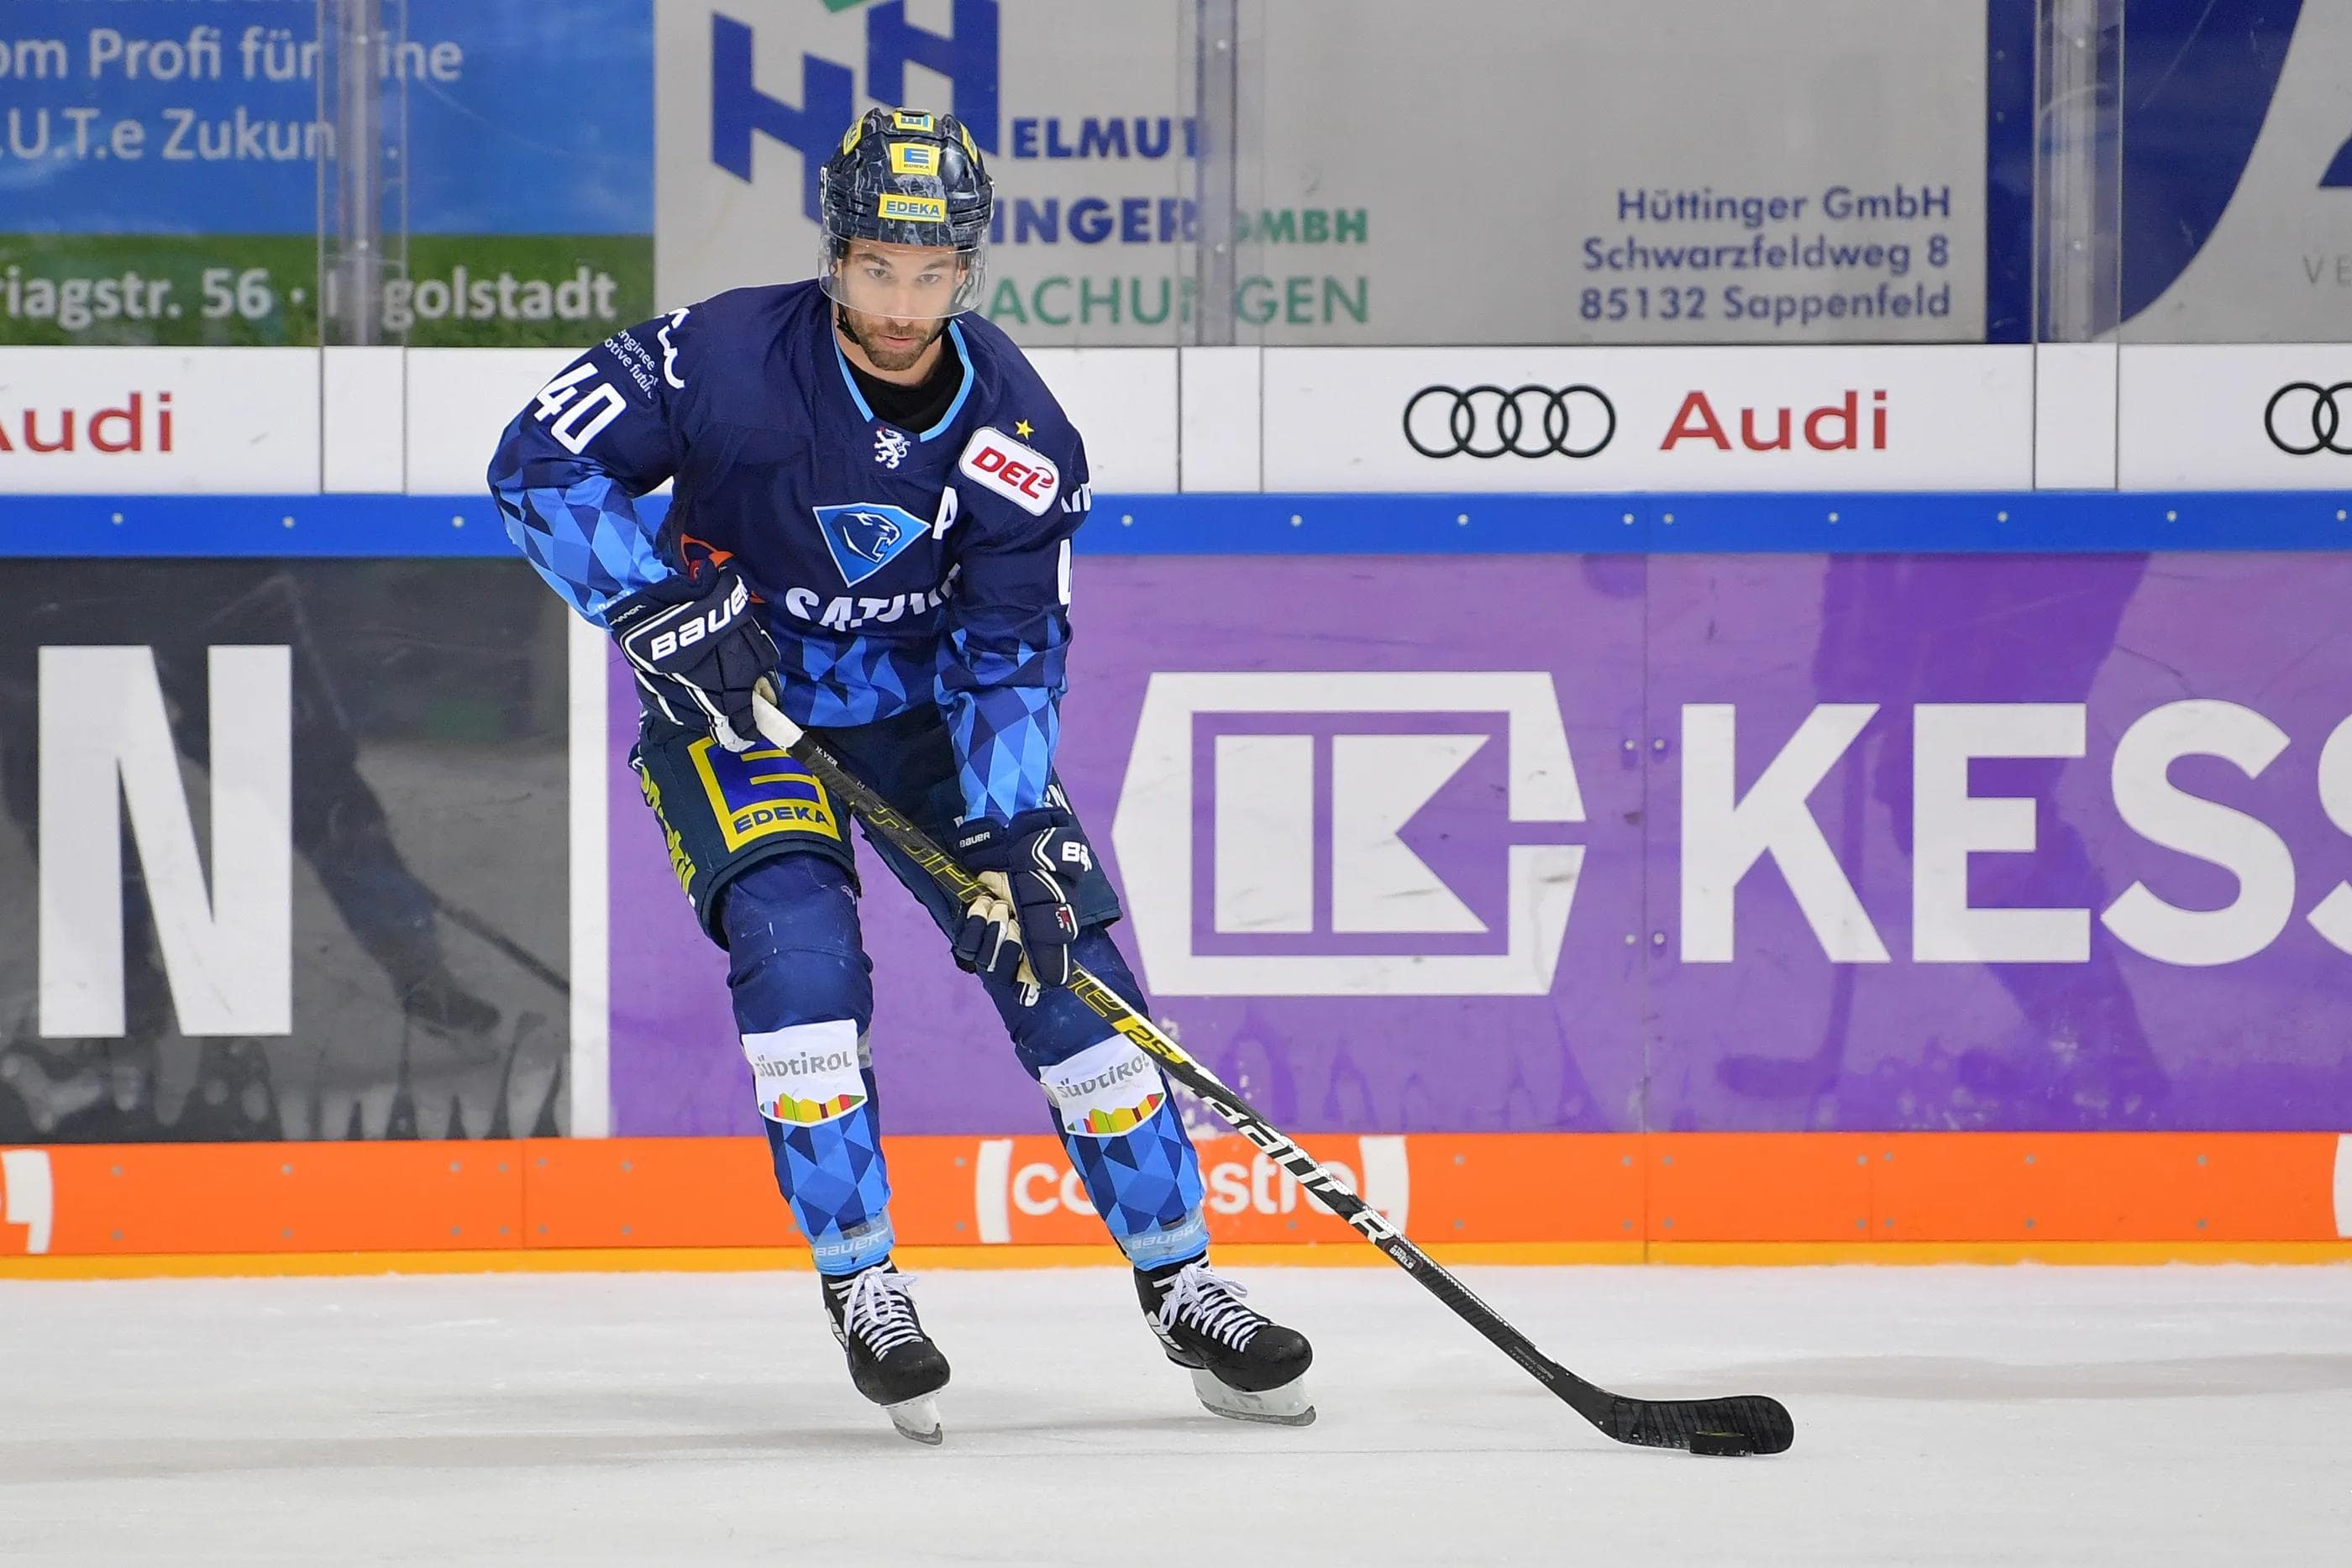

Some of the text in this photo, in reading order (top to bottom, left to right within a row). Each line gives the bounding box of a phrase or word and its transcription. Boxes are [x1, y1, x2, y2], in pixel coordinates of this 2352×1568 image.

[0, 39, 67, 79] m
[88, 25, 222, 80] Profi
[240, 25, 321, 80] für
[885, 201, 941, 216] EDEKA
[1617, 184, 1950, 228] Hüttinger GmbH
[1583, 233, 1950, 277] Schwarzfeldweg 8
[0, 265, 617, 331] iagstr. 56 Igolstadt
[1579, 281, 1950, 327] 85132 Sappenfeld
[0, 390, 173, 452] udi
[533, 362, 627, 455] 40
[1660, 390, 1888, 451] Audi
[971, 446, 1054, 500] DEL
[732, 805, 832, 834] EDEKA
[1681, 698, 2352, 967] KES
